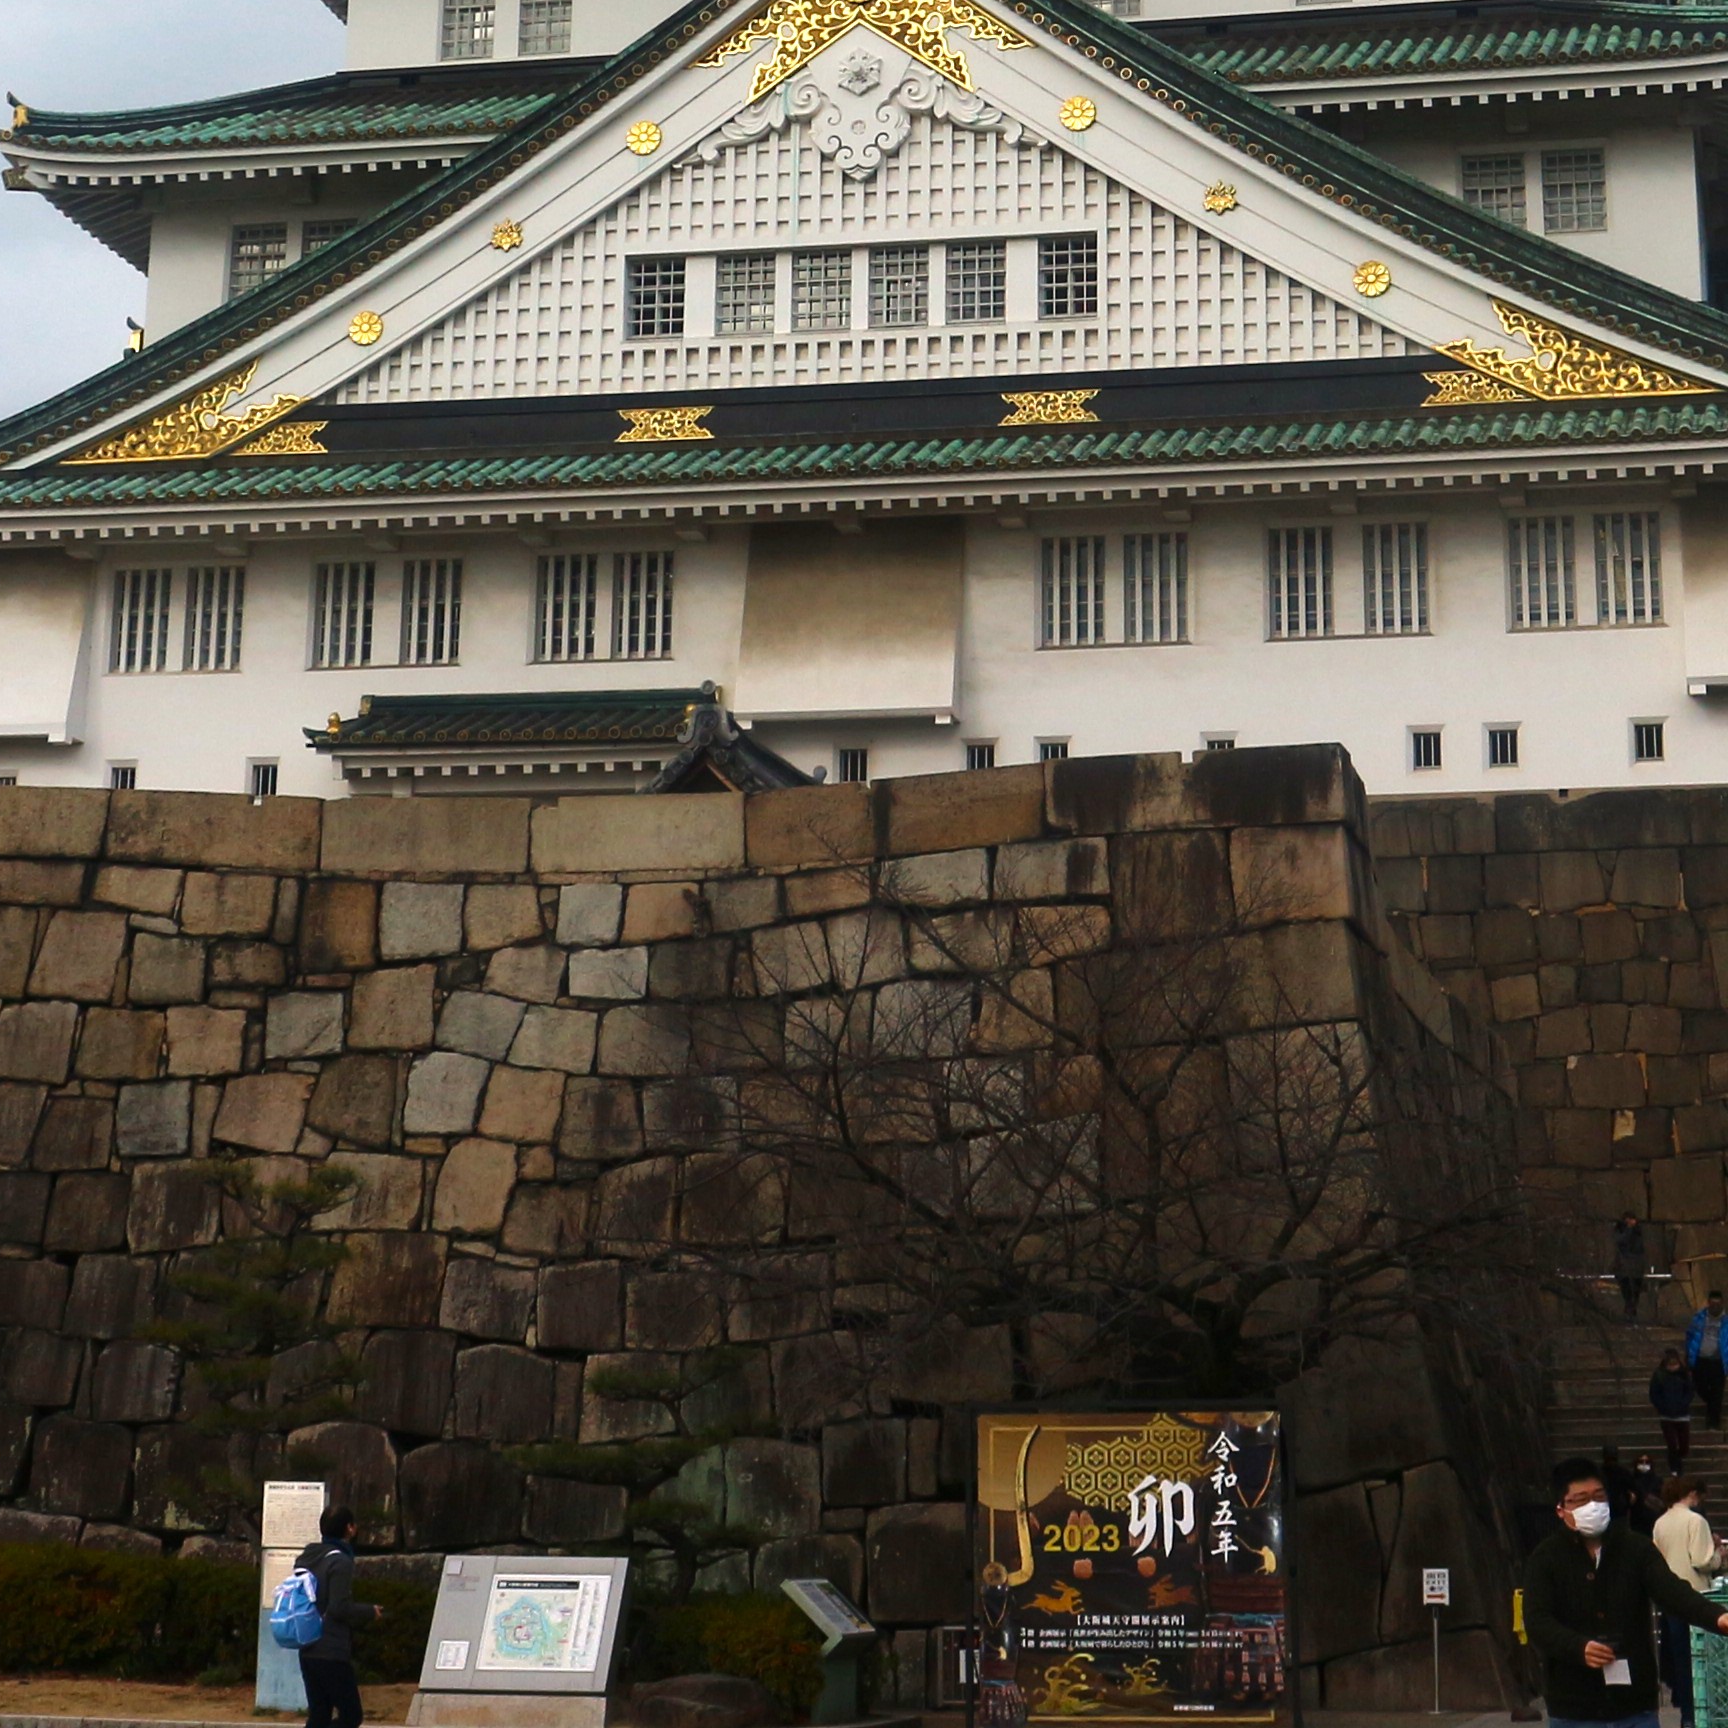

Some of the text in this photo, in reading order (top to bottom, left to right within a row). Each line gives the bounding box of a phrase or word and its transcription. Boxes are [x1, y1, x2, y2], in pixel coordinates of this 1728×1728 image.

[1043, 1524, 1121, 1552] 2023
[1127, 1475, 1195, 1558] 卯
[1207, 1431, 1240, 1563] 令和五年
